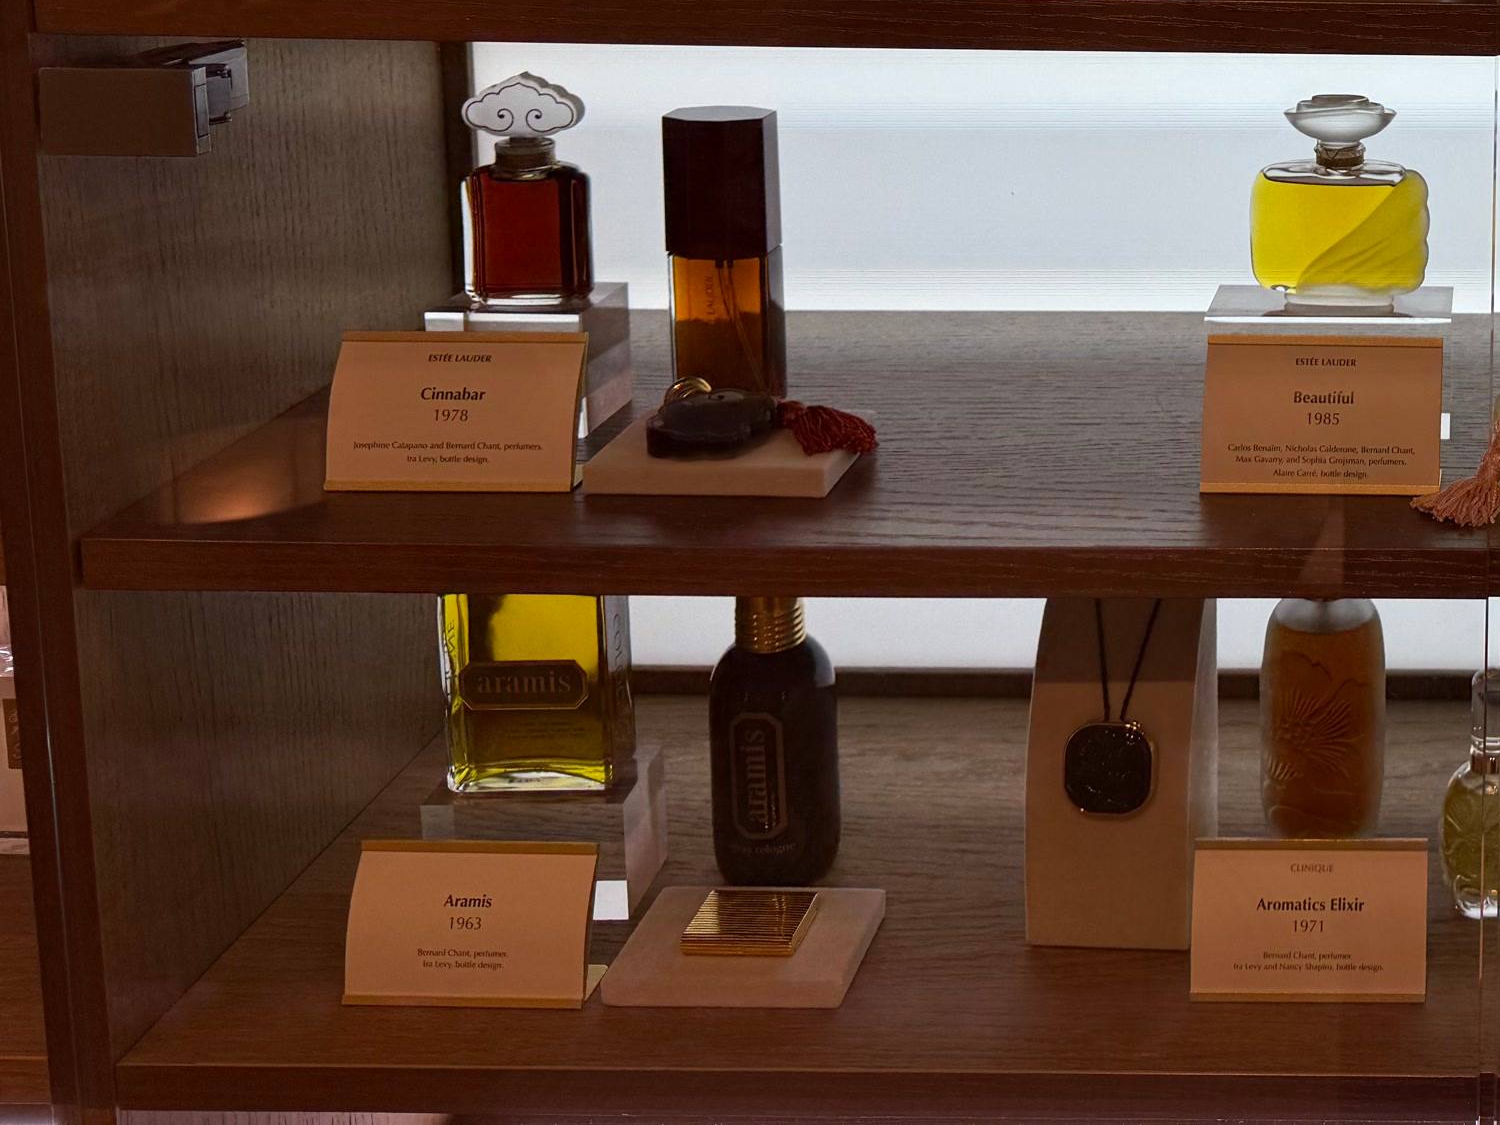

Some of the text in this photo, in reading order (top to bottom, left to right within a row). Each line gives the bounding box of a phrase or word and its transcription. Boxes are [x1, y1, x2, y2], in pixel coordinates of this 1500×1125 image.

[428, 354, 492, 363] ESTÉE LAUDER
[1296, 357, 1357, 367] ESTÉE LAUDER
[420, 387, 485, 401] Cinnabar
[1294, 391, 1354, 404] Beautiful
[434, 409, 468, 421] 1978
[1307, 412, 1339, 425] 1985
[430, 442, 444, 450] and
[446, 442, 475, 450] Bernard
[1285, 444, 1317, 452] Nicholas
[1361, 446, 1390, 454] Bernard
[1286, 456, 1300, 464] and
[1302, 456, 1327, 466] Sophia
[477, 670, 572, 694] aramis
[739, 729, 767, 822] aramis
[1290, 863, 1334, 873] CLINIQUE
[444, 894, 492, 907] Aramis
[1257, 898, 1364, 912] Aromatics Elixir
[449, 917, 482, 930] 1963
[1293, 920, 1324, 932] 1971
[417, 948, 447, 956] Bernard
